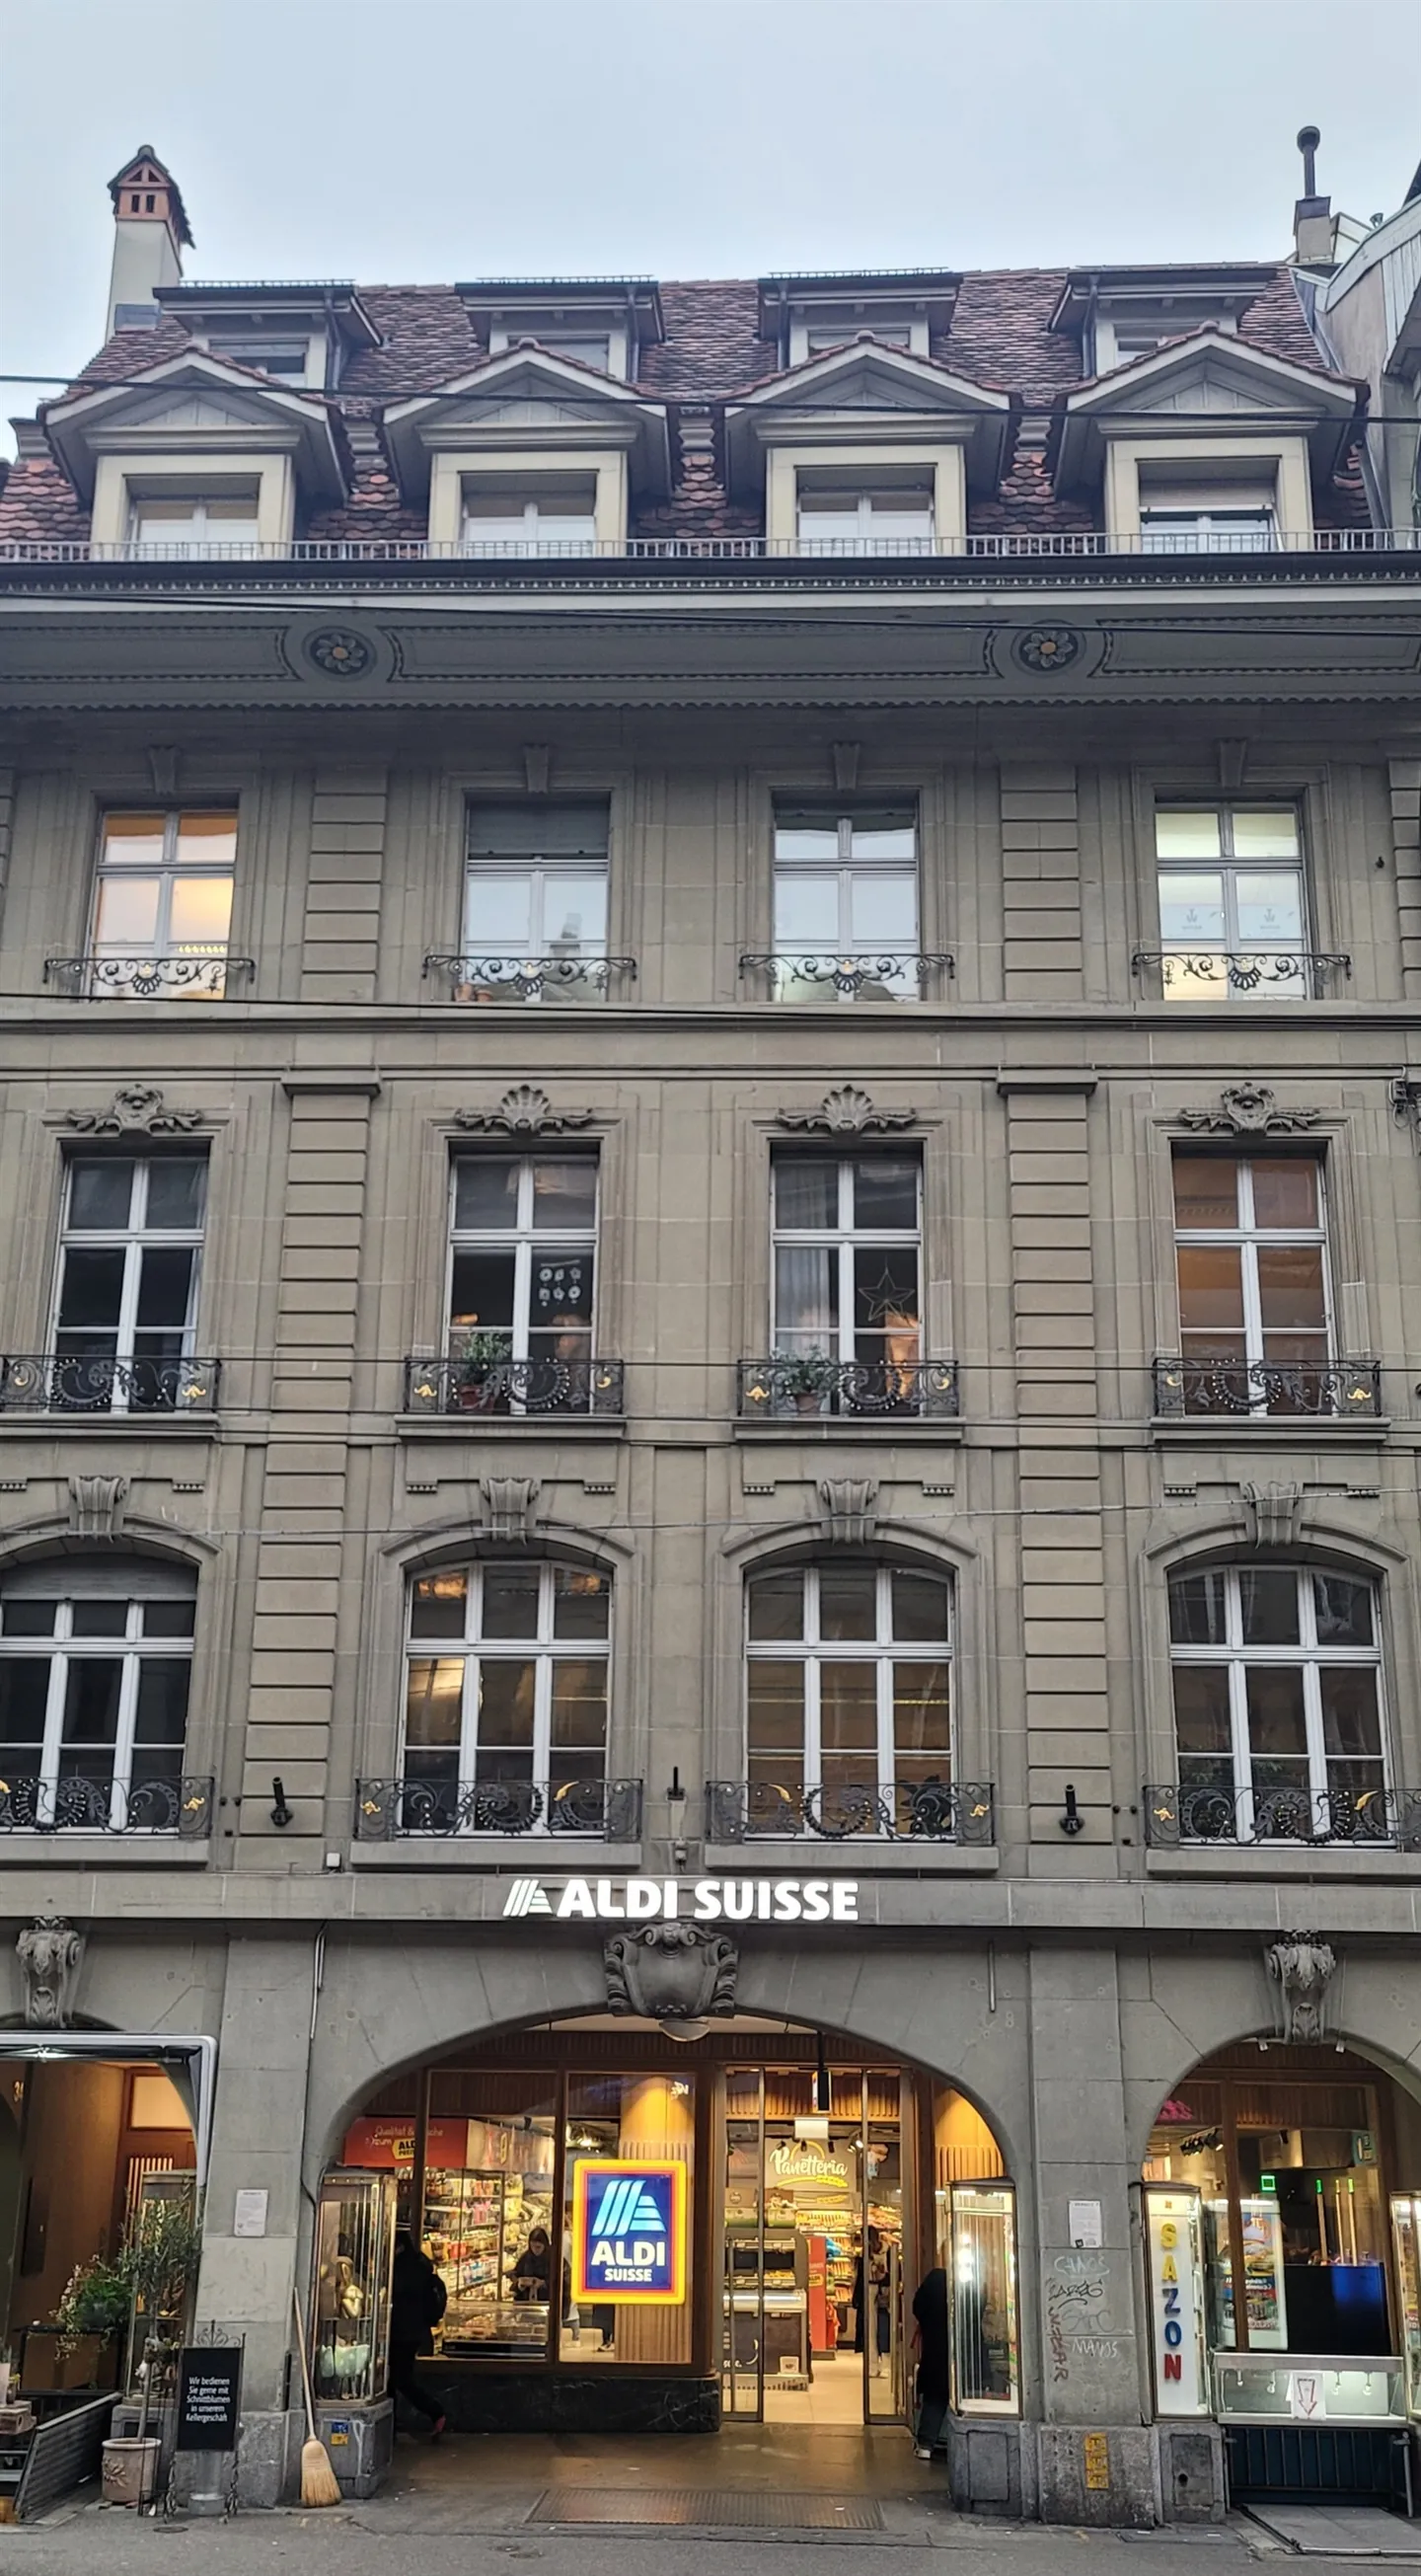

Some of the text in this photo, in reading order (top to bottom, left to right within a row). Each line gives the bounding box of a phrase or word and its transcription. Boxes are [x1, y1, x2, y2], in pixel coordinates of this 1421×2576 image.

[557, 1879, 859, 1921] ALDI SUISSE
[398, 2140, 415, 2151] ALD
[769, 2146, 849, 2177] Panetteria
[591, 2240, 665, 2266] ALDI
[604, 2268, 652, 2282] SUISSE
[1159, 2223, 1182, 2381] SAZON
[188, 2376, 230, 2386] Wir bedienen
[188, 2386, 229, 2396] Sie gerne mit
[187, 2394, 231, 2403] Schnittblumen
[186, 2412, 228, 2424] Kellergeschäft
